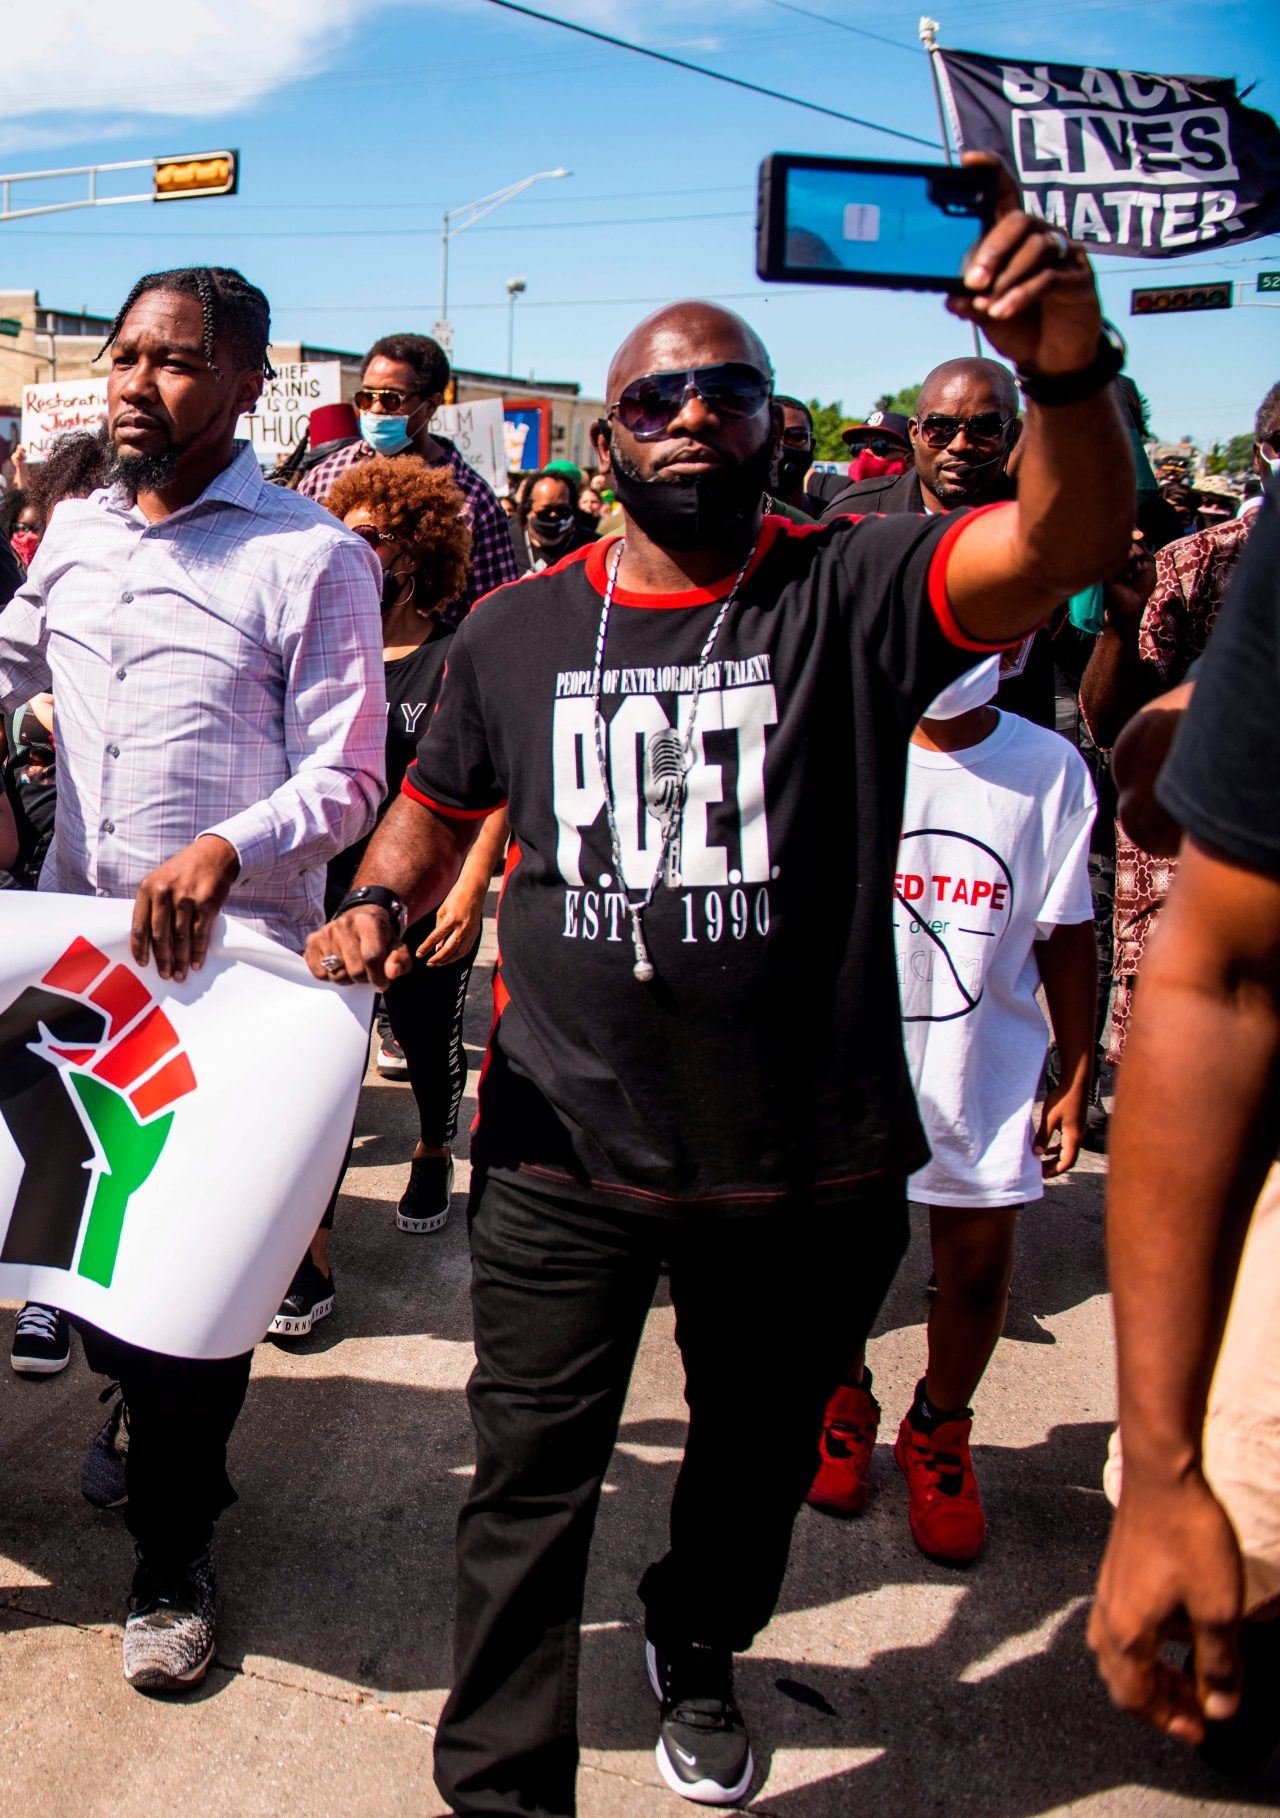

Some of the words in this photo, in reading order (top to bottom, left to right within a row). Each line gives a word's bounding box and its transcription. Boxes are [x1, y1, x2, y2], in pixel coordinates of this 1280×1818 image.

[1019, 115, 1229, 175] LIVES
[1022, 188, 1246, 249] MATTER
[274, 364, 308, 379] HIEF
[26, 391, 109, 414] Restorativ
[555, 670, 601, 697] PEOPL
[602, 669, 620, 694] OF
[723, 653, 771, 687] TALENT
[931, 875, 1009, 911] TAPE
[680, 887, 771, 944] 1990
[448, 1035, 461, 1075] DKNY
